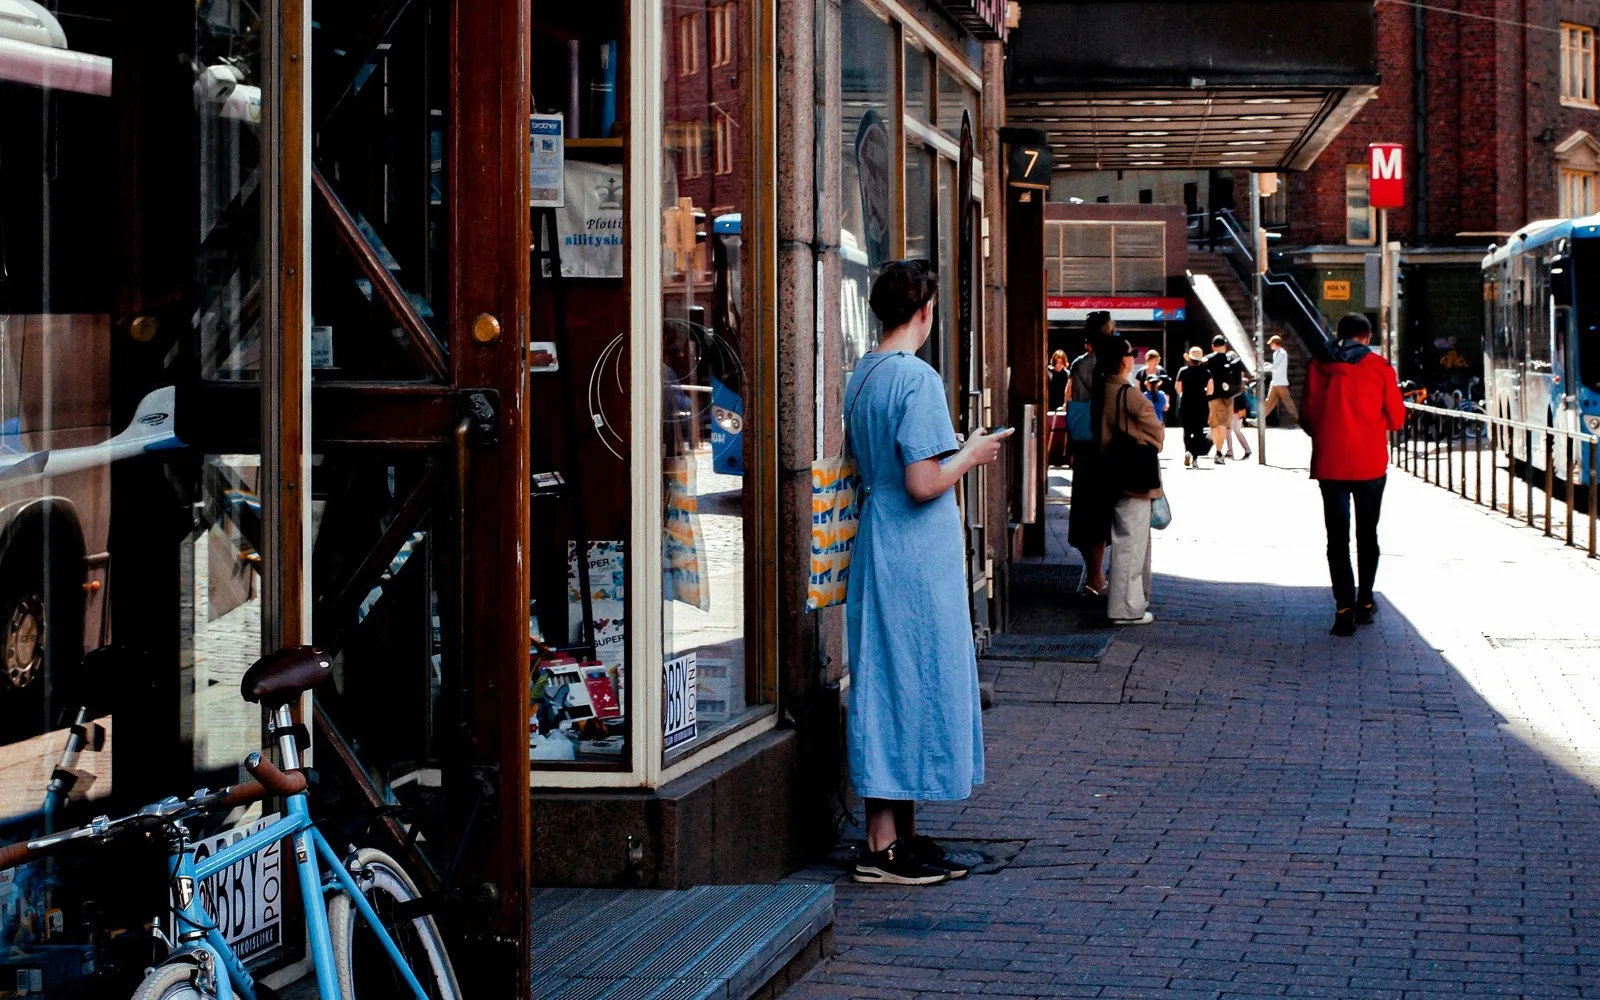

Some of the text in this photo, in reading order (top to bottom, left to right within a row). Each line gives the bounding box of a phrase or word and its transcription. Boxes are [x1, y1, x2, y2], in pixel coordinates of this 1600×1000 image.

[531, 121, 558, 129] brother
[1024, 150, 1039, 178] 7
[1371, 148, 1402, 180] M
[586, 217, 624, 230] Plotti
[588, 558, 610, 569] PER
[594, 634, 624, 648] SUPER
